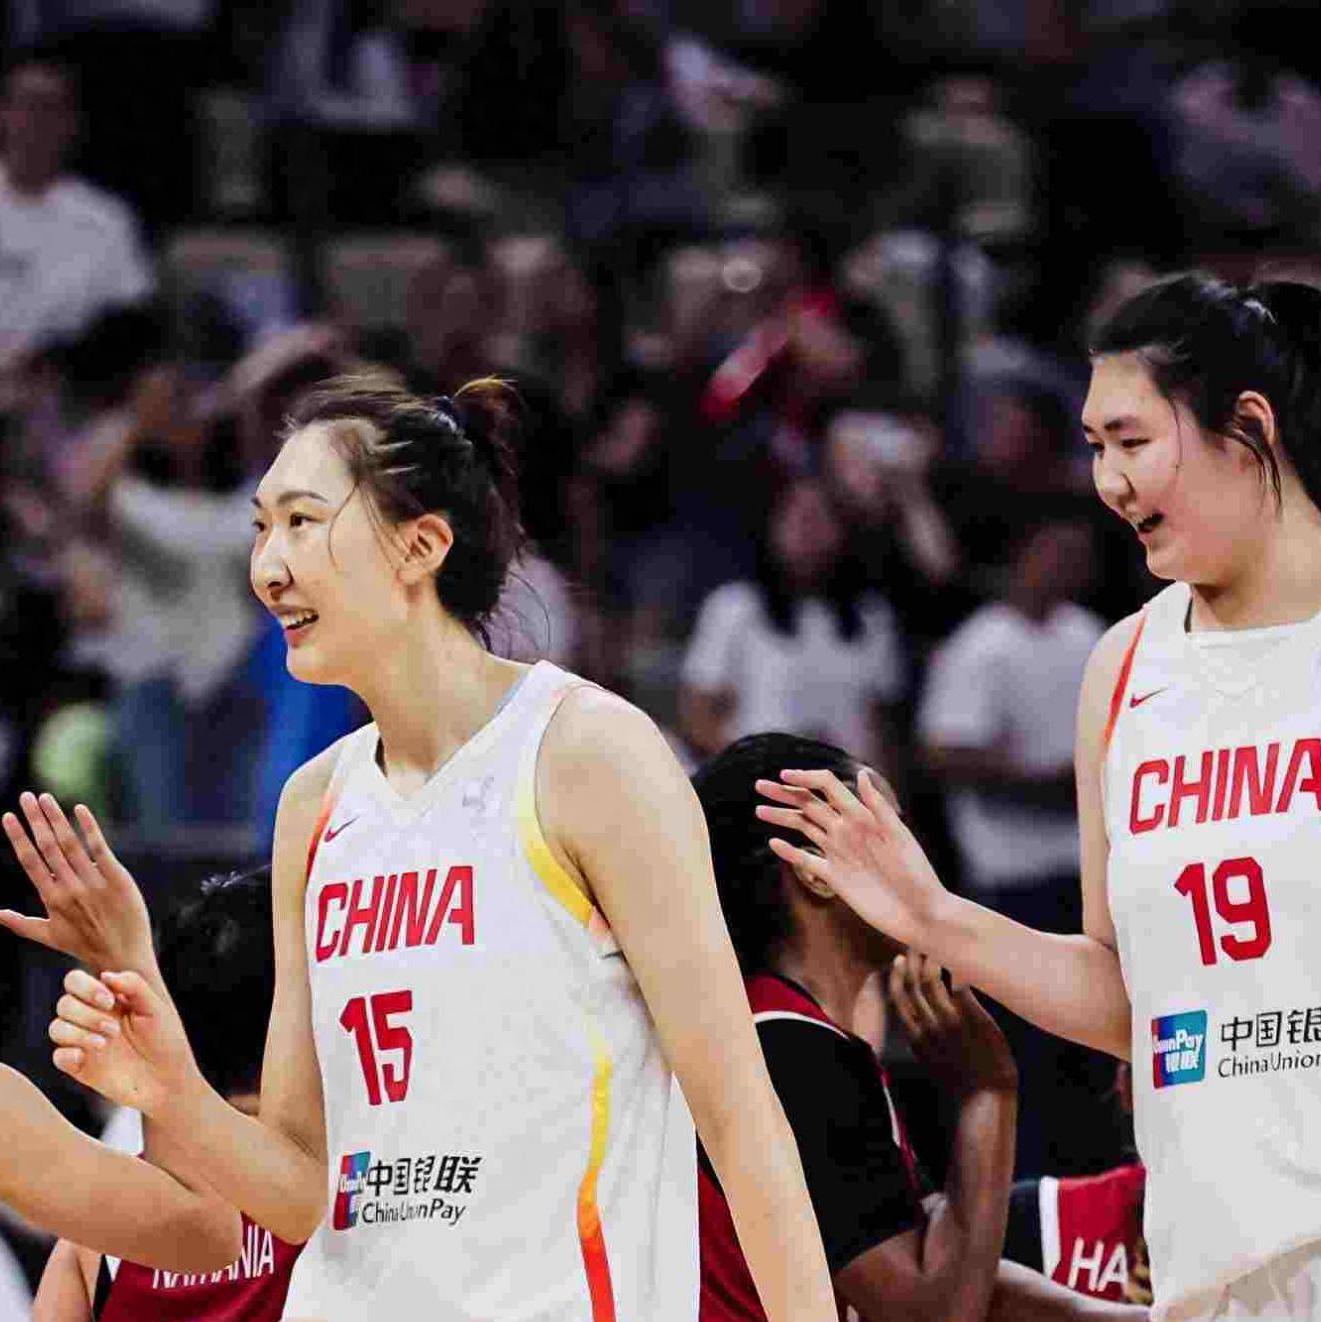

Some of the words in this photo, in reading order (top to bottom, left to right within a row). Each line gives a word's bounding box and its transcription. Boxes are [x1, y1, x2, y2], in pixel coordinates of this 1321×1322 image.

[315, 864, 475, 963] CHINA
[1173, 856, 1273, 966] 19
[339, 989, 413, 1106] 15
[366, 1155, 483, 1197] 中国银联
